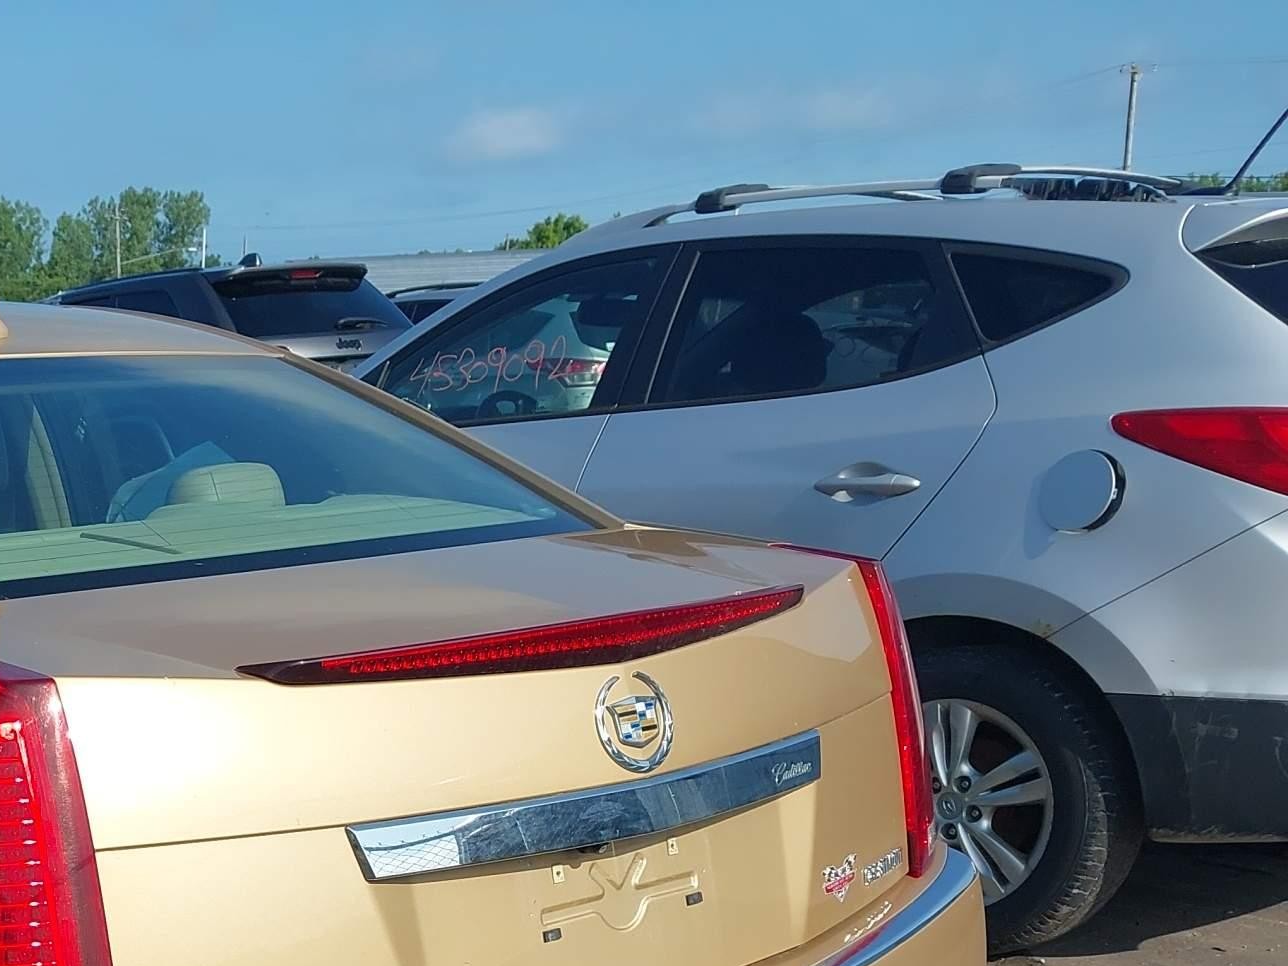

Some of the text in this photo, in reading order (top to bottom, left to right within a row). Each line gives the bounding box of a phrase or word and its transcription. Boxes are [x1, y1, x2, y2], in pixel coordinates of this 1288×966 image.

[335, 337, 362, 352] Jeep
[409, 334, 572, 398] 45309092
[771, 761, 812, 786] Cadillac
